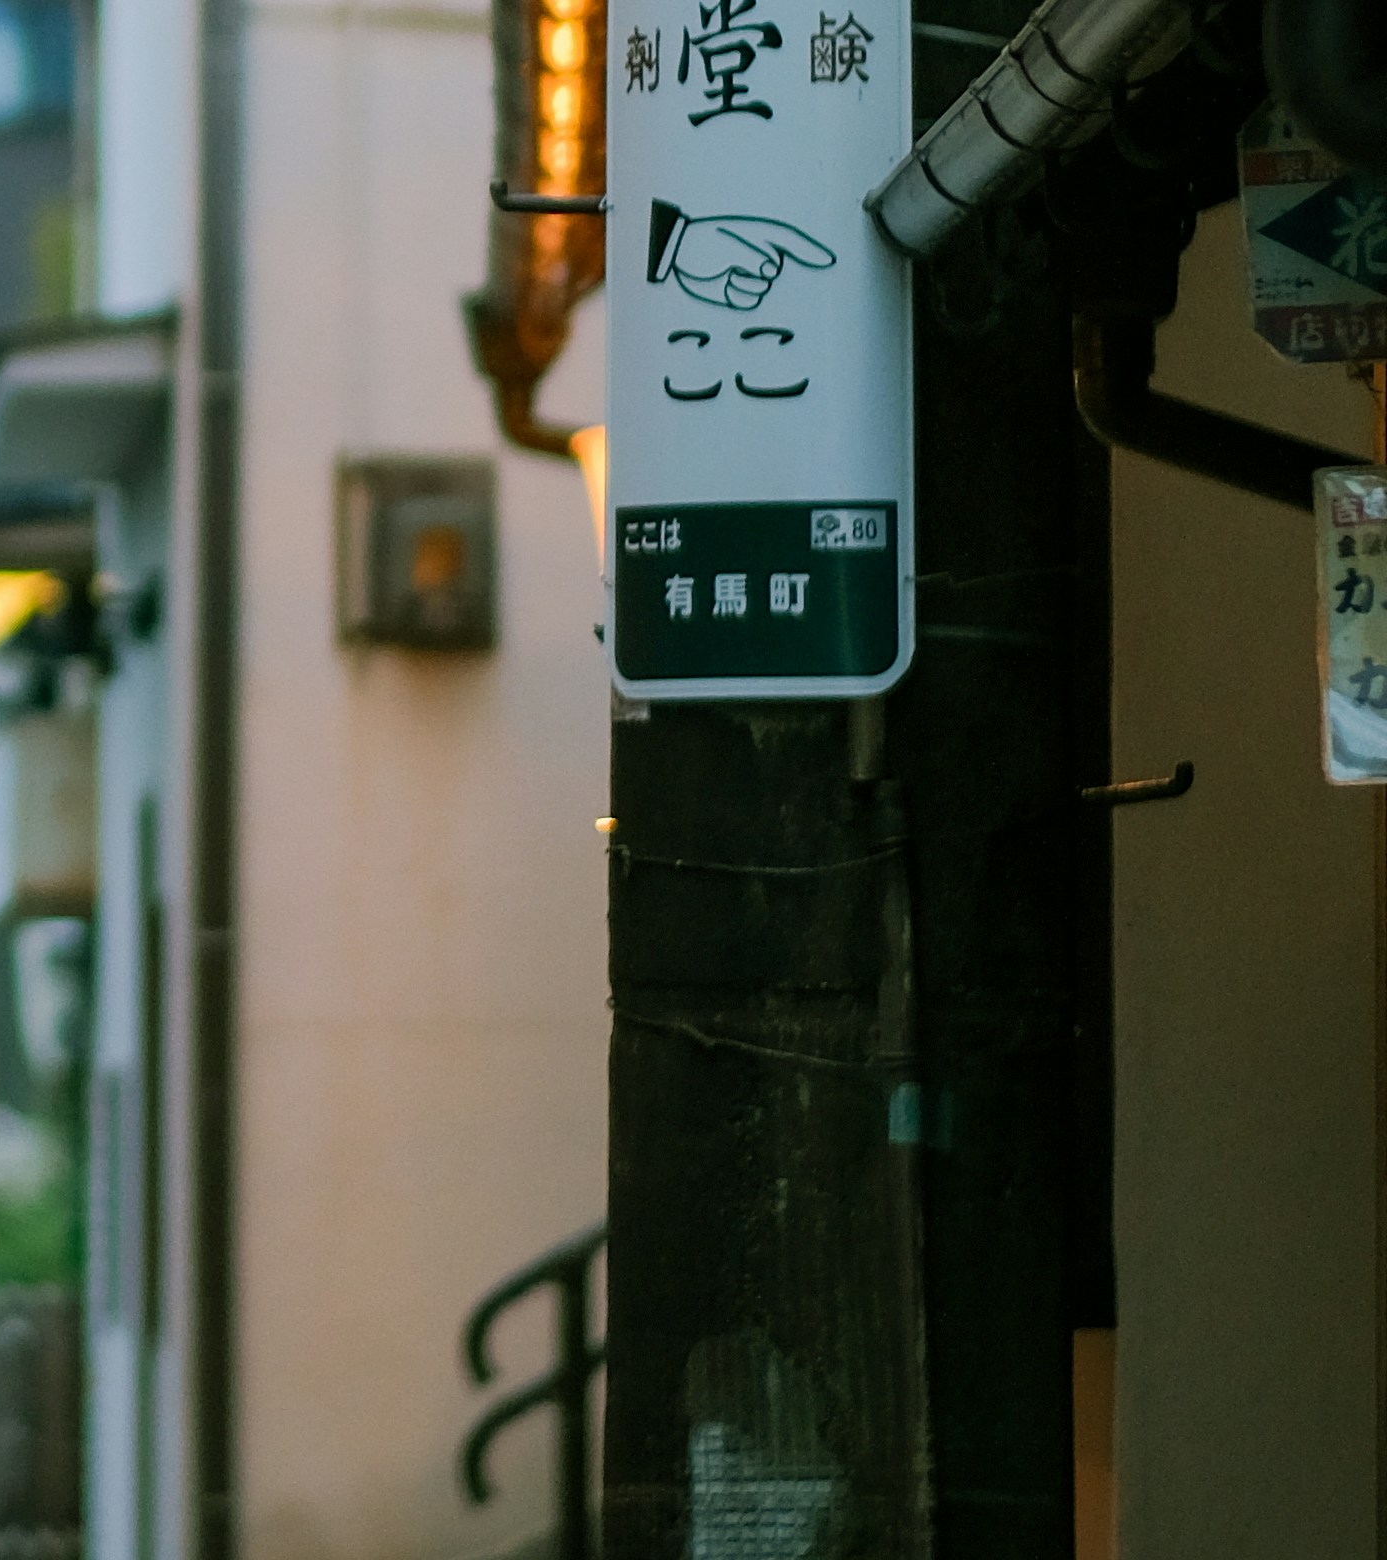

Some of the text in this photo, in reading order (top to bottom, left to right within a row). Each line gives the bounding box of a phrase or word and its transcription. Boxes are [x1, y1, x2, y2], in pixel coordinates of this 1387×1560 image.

[663, 326, 811, 401] ここ
[625, 517, 683, 553] ここは
[852, 517, 878, 540] 80
[664, 573, 811, 619] 有馬町
